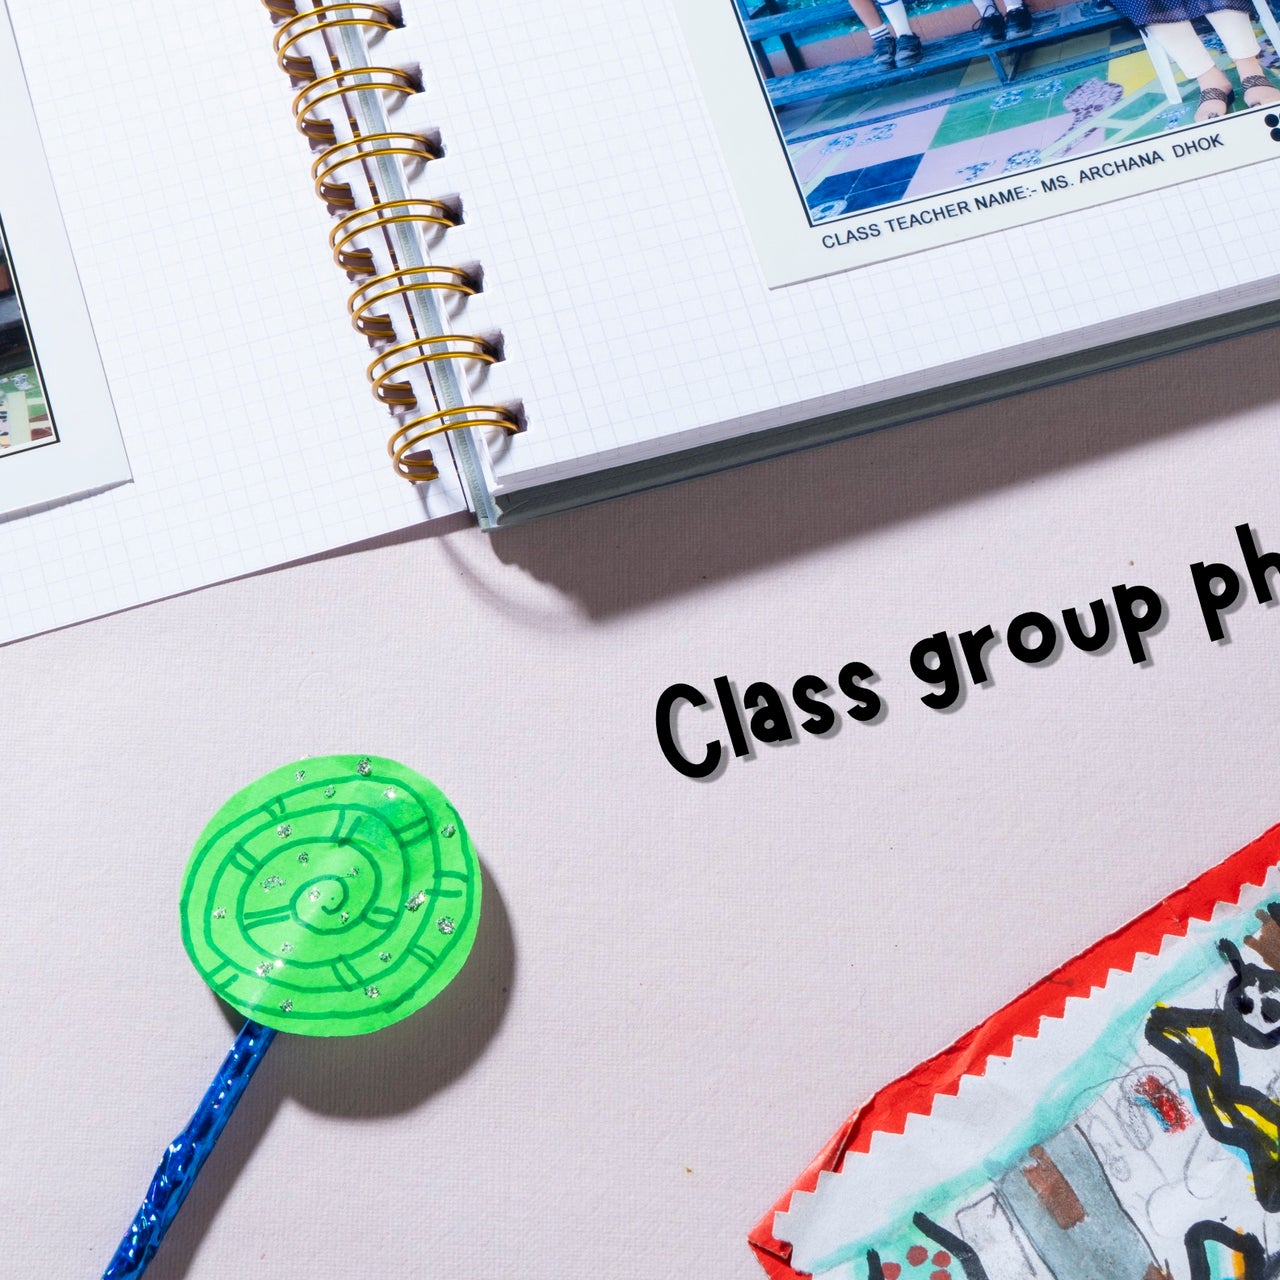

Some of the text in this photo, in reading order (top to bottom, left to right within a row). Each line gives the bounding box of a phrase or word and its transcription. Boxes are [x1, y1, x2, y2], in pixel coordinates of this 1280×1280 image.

[822, 224, 881, 248] CLASS
[884, 201, 972, 232] TEACHER
[1041, 175, 1074, 193] MS.
[1080, 151, 1165, 183] ARCHANA
[1172, 133, 1224, 158] DHOK
